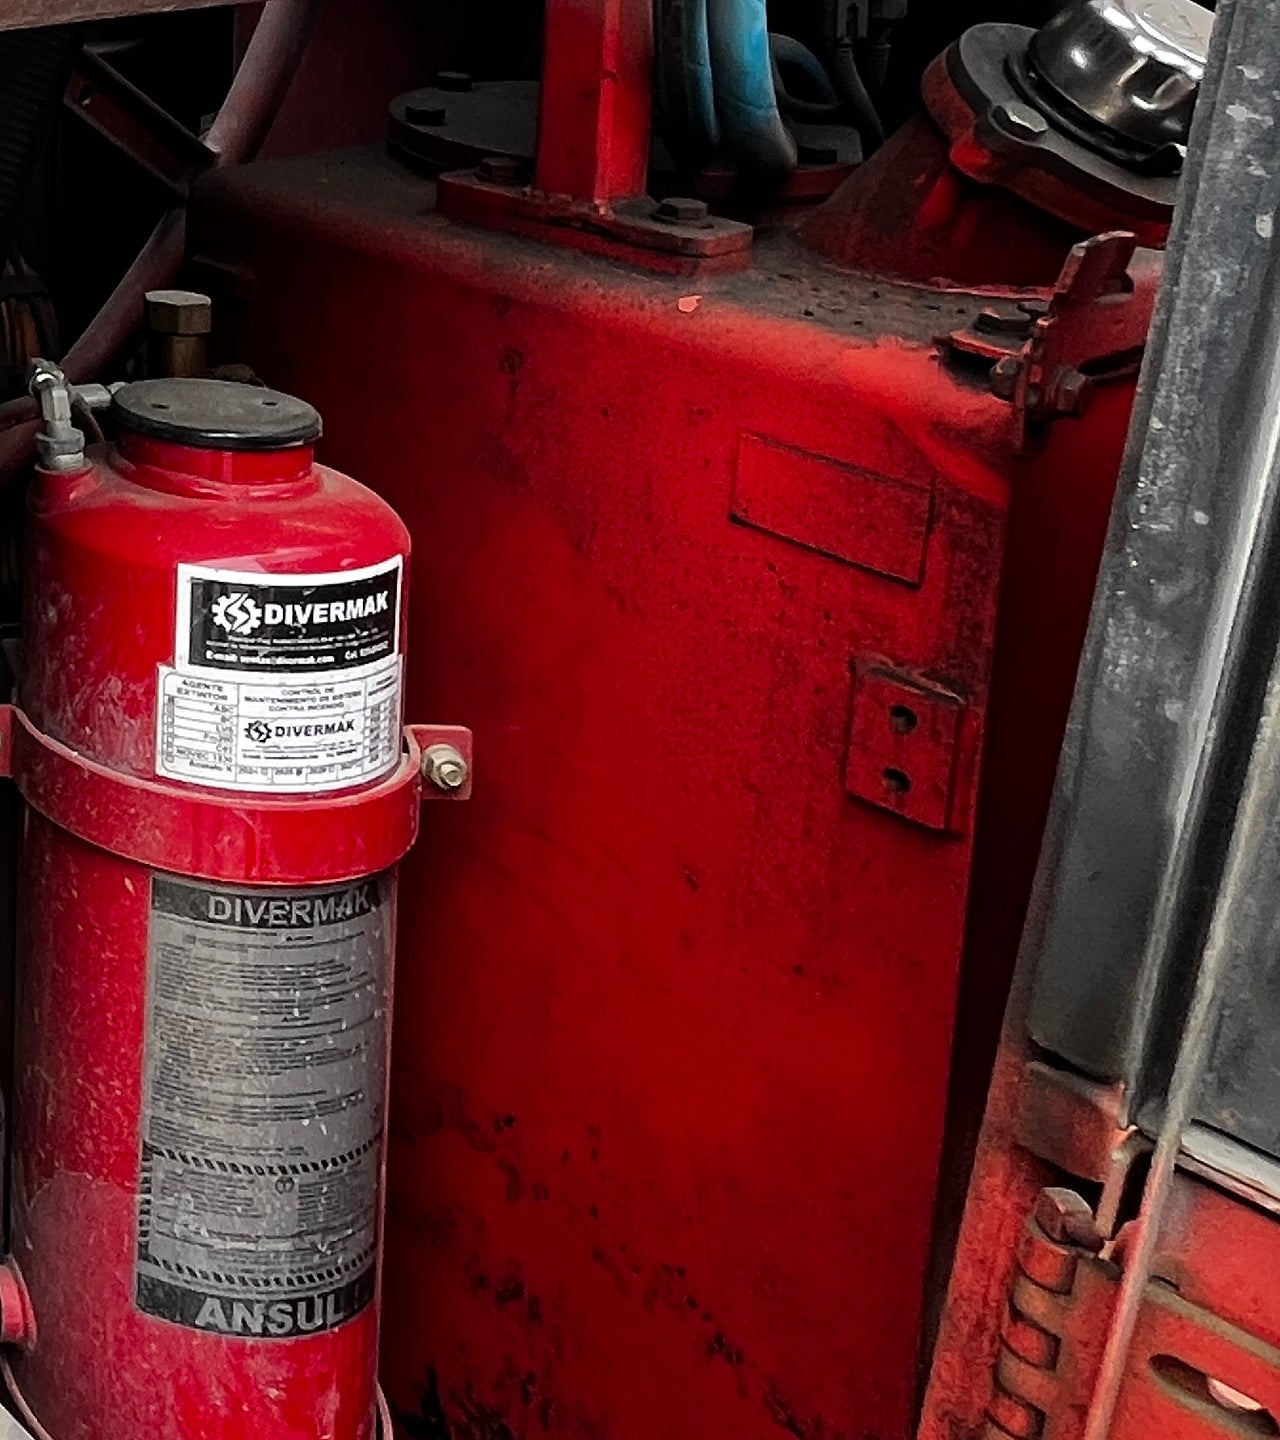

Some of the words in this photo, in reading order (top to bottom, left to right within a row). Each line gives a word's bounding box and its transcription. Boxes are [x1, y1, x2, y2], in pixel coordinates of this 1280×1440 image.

[264, 591, 389, 625] DIVERMAK
[275, 719, 355, 737] DIVERMAK
[208, 887, 371, 927] DIVERMAK
[195, 1292, 352, 1336] ANSUL
